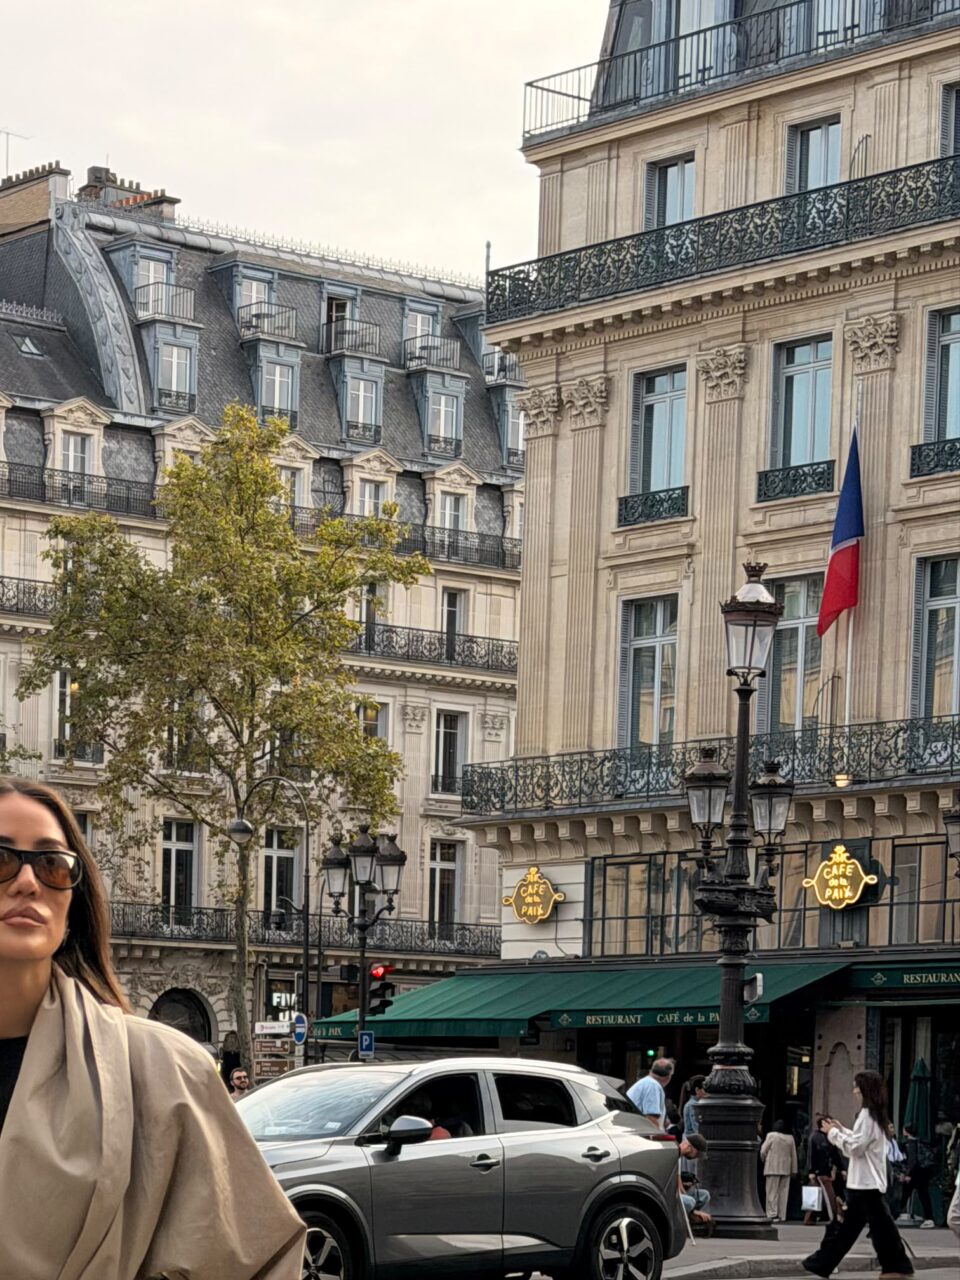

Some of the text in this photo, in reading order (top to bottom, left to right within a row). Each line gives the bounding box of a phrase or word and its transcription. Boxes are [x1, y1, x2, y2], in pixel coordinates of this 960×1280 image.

[828, 877, 848, 887] de la
[825, 886, 853, 900] PAIX
[521, 904, 544, 916] PAIX
[903, 972, 960, 984] RESTAURAN
[585, 1011, 720, 1025] RESTAURANT CAFÉ de la PA
[362, 1035, 370, 1049] P
